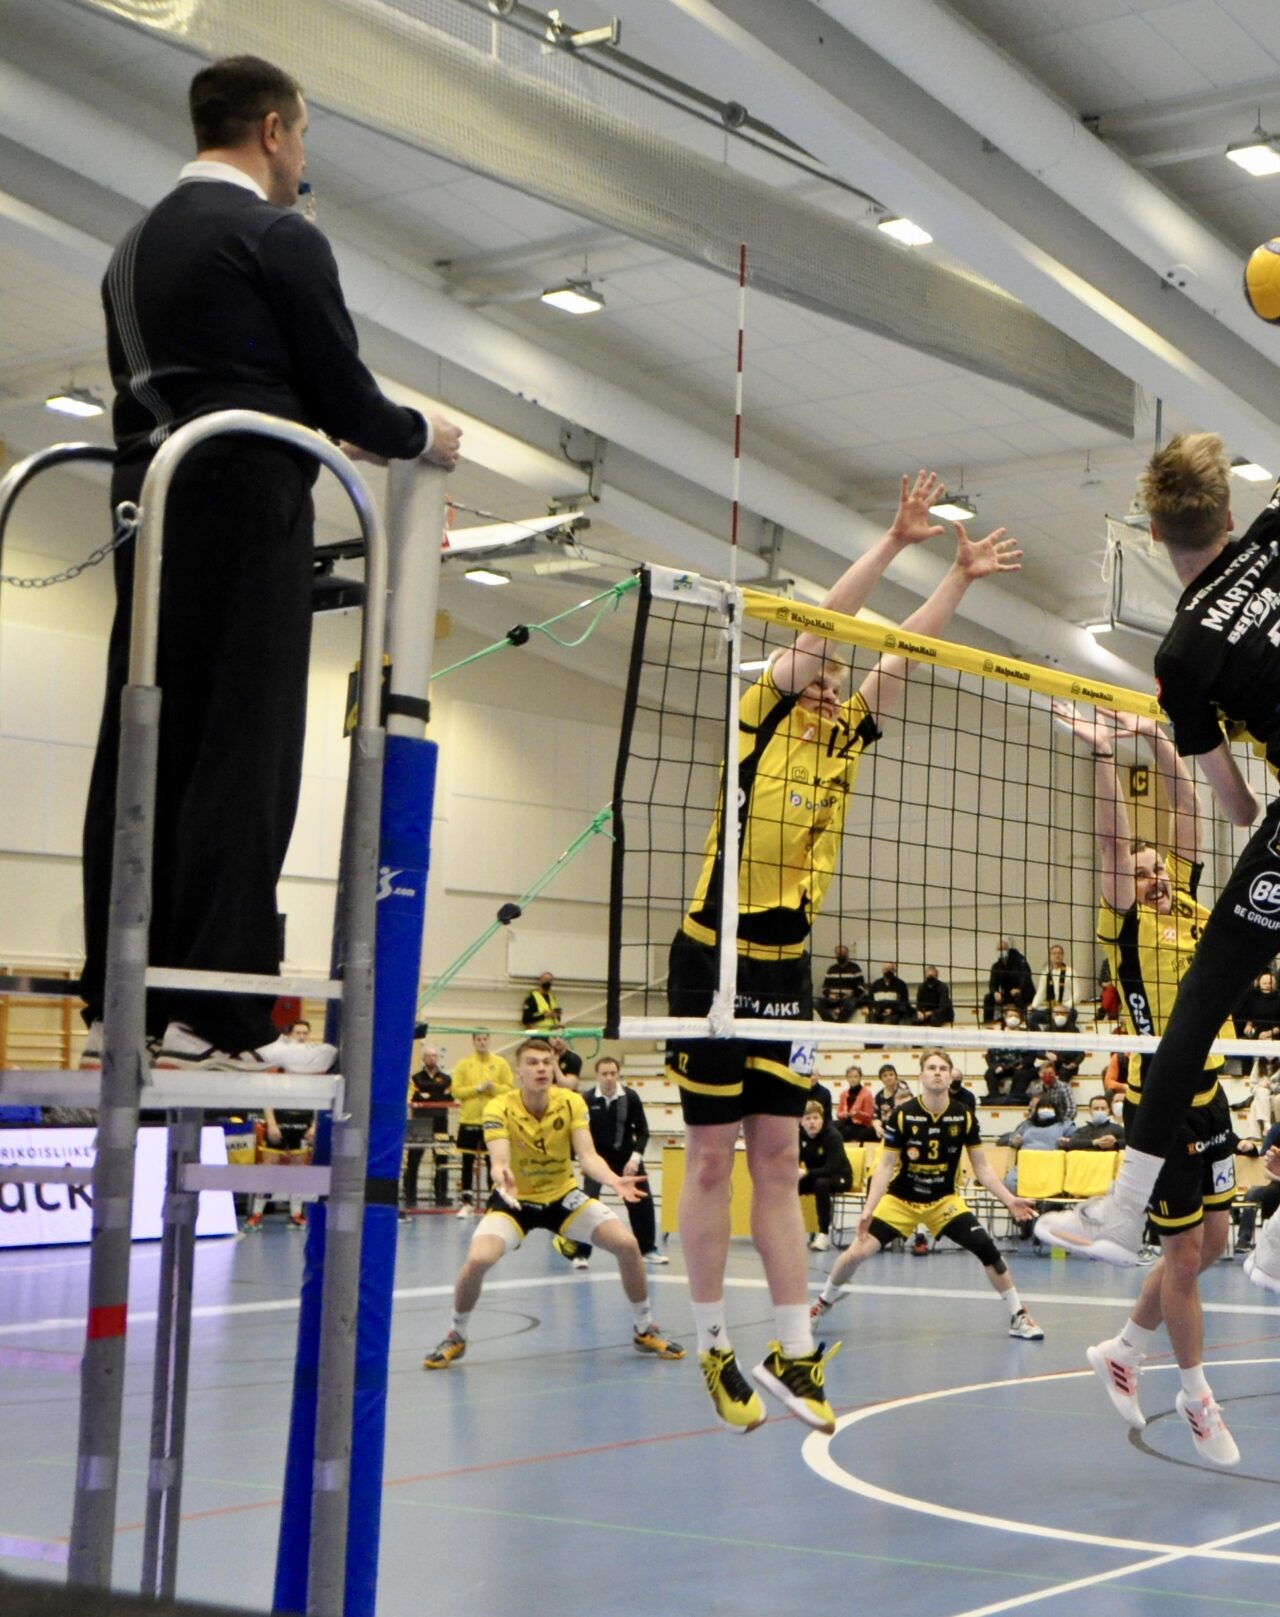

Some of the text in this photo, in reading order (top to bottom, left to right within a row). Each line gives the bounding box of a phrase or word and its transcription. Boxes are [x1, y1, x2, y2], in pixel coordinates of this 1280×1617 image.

[826, 717, 855, 761] 12
[1132, 771, 1147, 791] C
[1233, 904, 1248, 918] BE
[927, 1140, 940, 1160] 3
